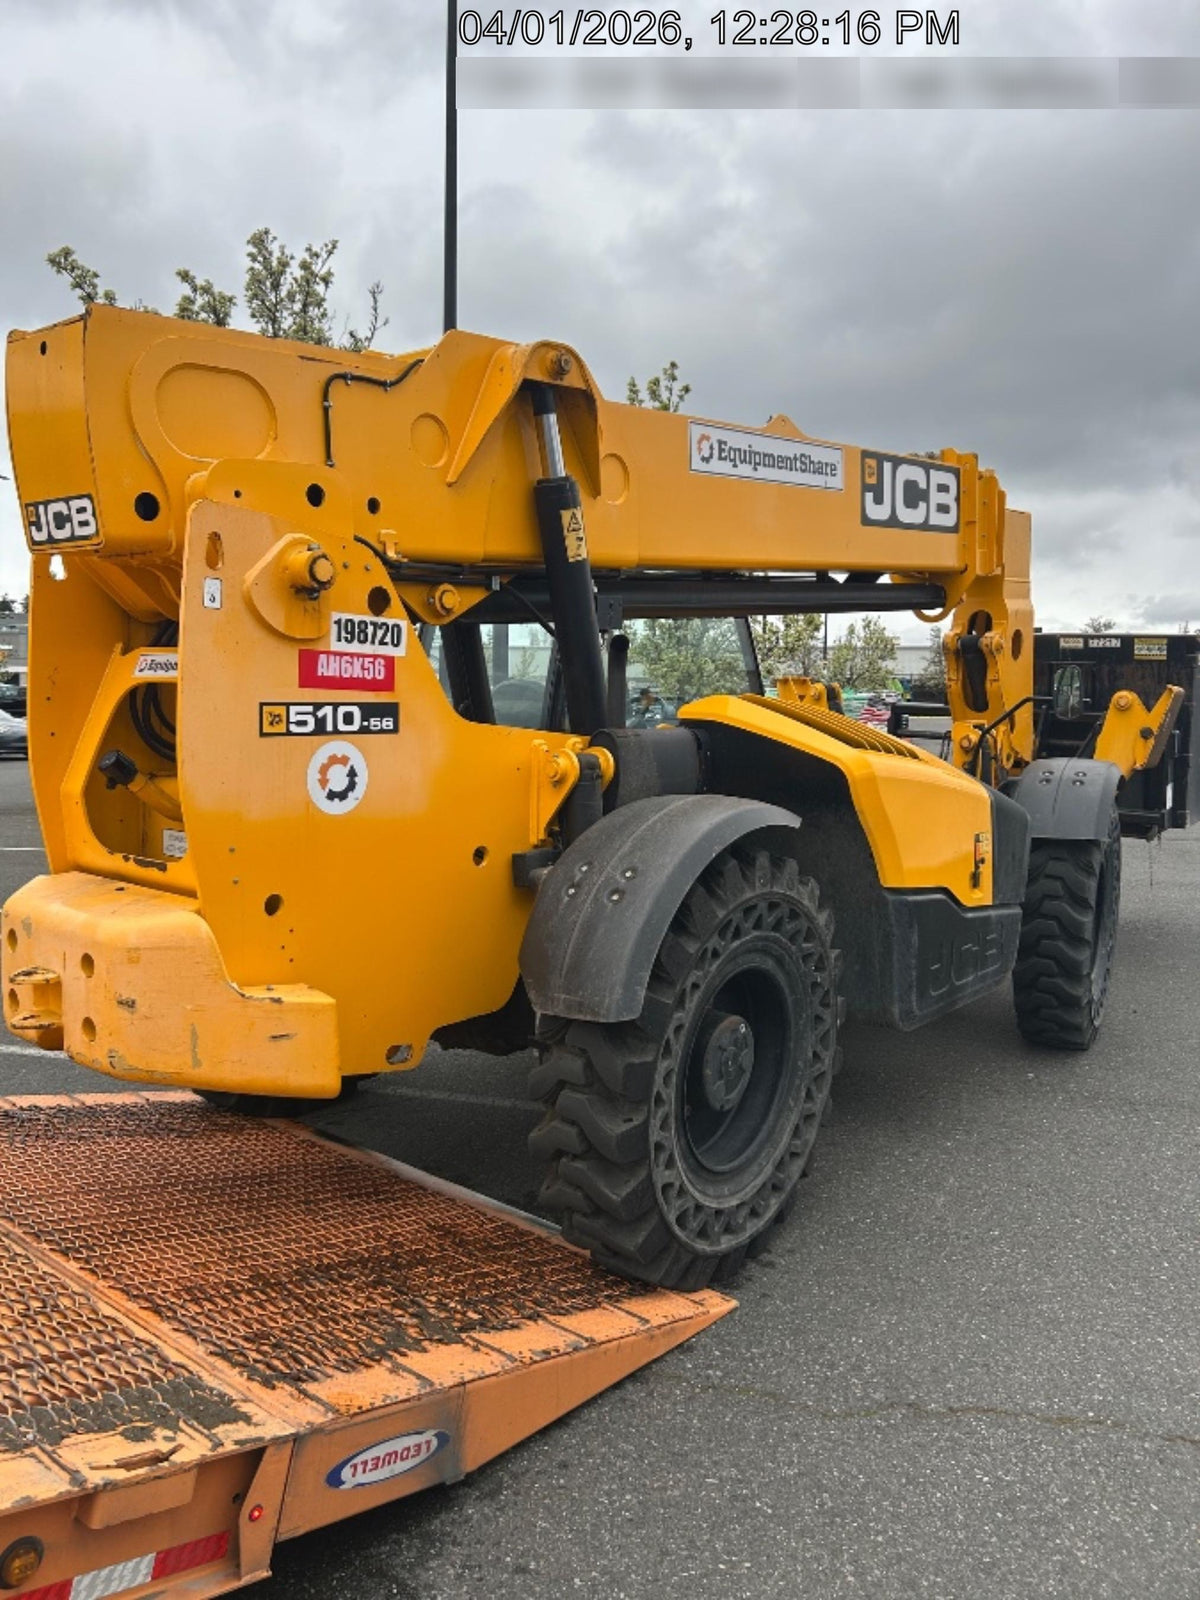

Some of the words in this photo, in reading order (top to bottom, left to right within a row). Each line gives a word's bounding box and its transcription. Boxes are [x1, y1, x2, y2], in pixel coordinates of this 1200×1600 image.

[716, 438, 838, 477] EquipmentShare
[864, 460, 958, 527] JCB
[30, 497, 97, 541] JCB
[334, 618, 402, 648] 198720
[289, 705, 394, 733] 510-56
[350, 1439, 432, 1478] LEDWELL
